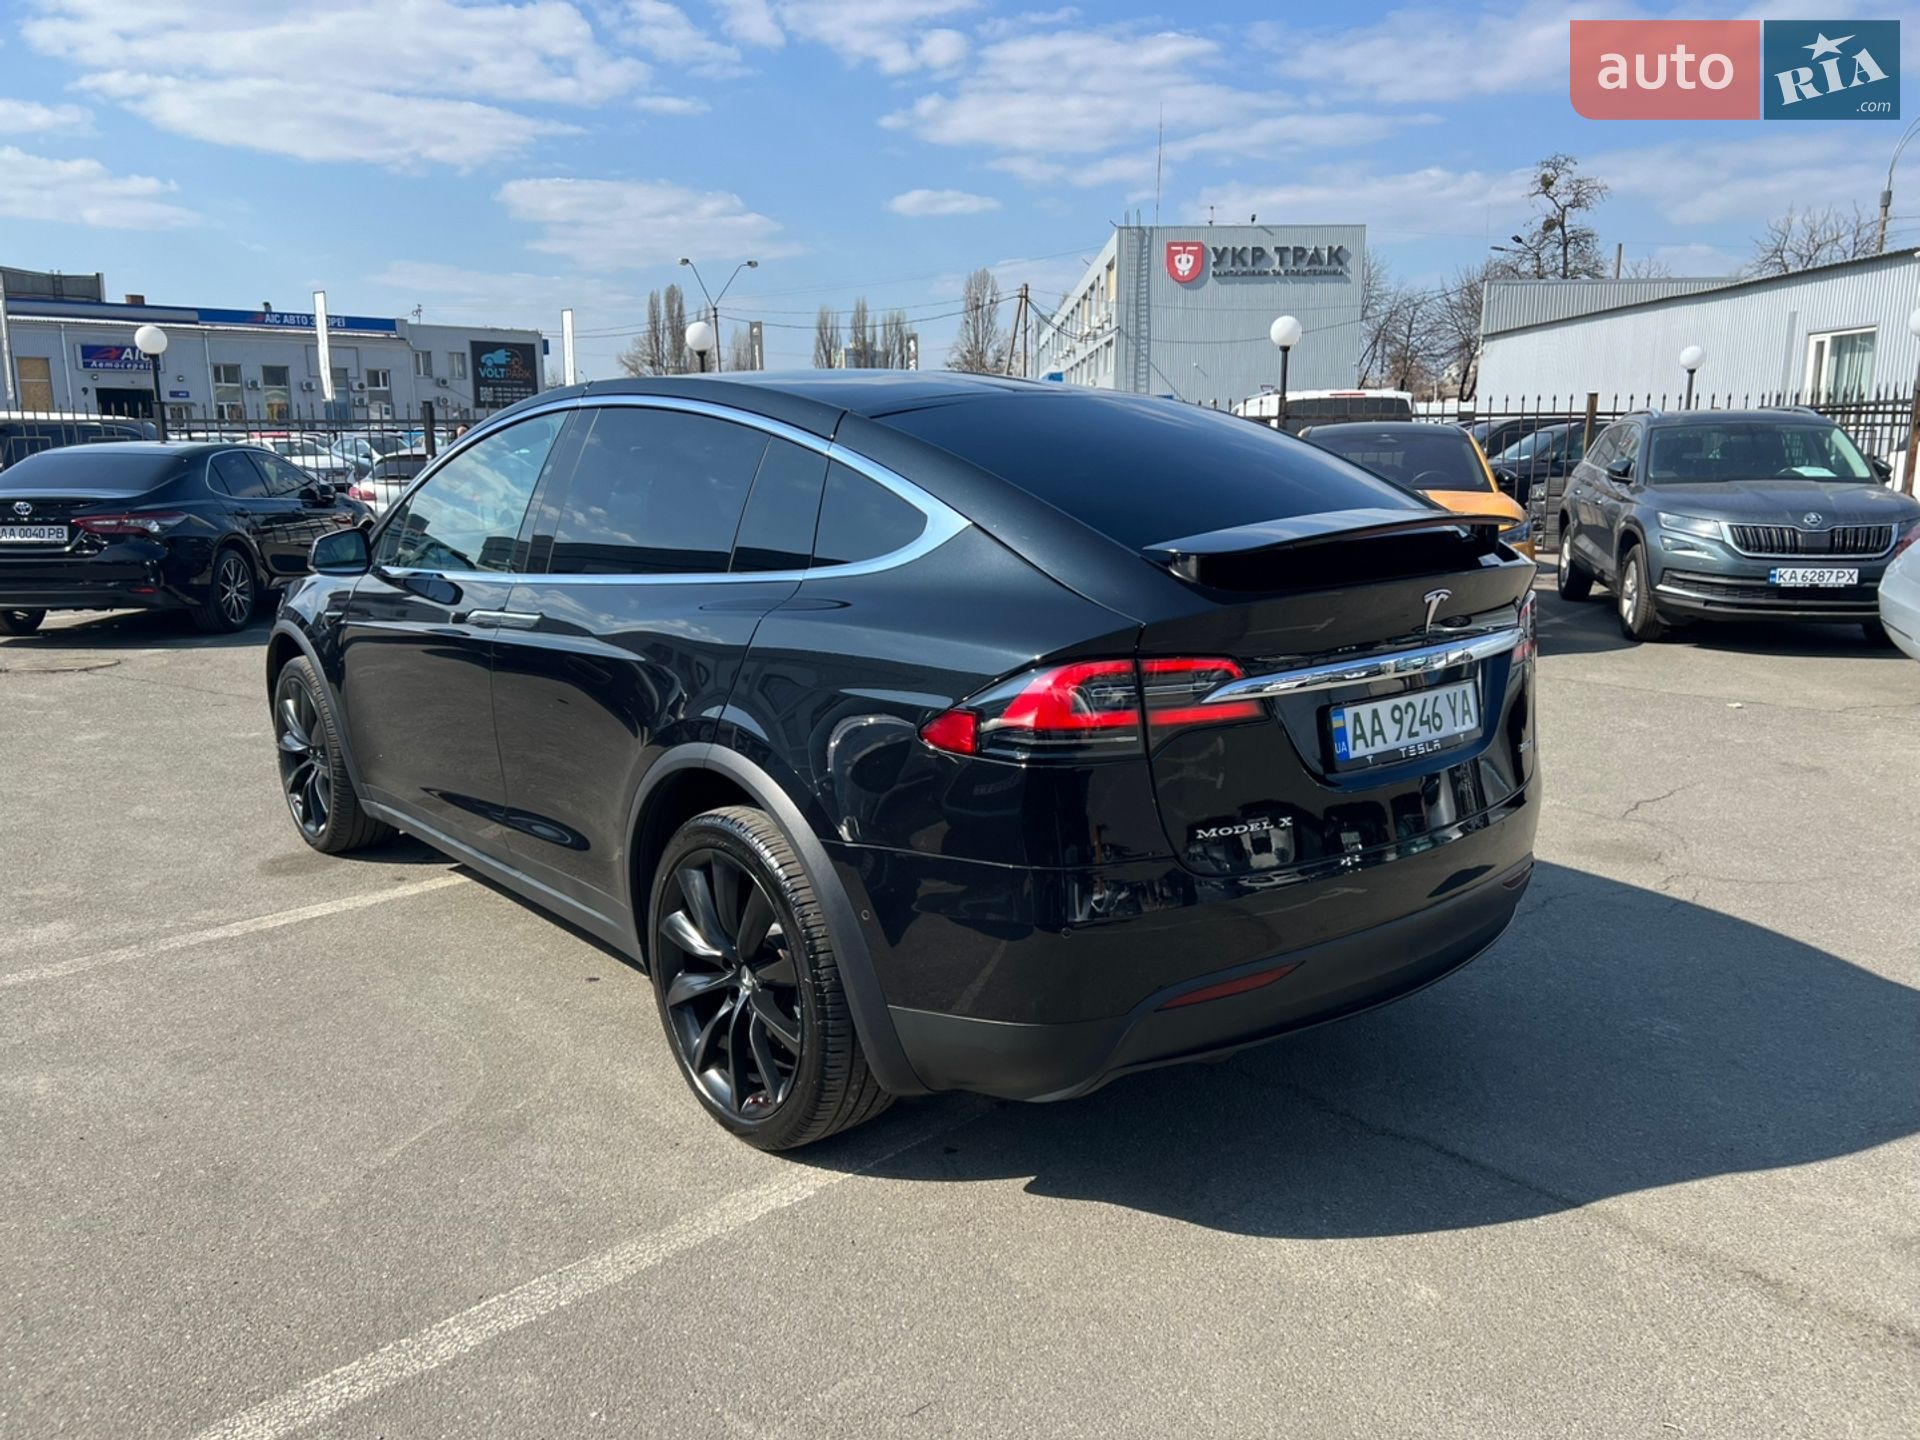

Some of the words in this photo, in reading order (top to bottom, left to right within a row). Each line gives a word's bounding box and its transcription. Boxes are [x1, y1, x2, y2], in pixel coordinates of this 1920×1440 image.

[1212, 246, 1266, 267] УКР
[1274, 245, 1344, 266] ТРАК
[283, 314, 308, 325] АВТО
[1, 528, 16, 539] AA
[18, 528, 45, 538] 0040
[48, 528, 64, 539] PB
[1778, 570, 1797, 582] KA
[1801, 570, 1833, 582] 6287
[1835, 571, 1856, 583] PX
[1352, 708, 1387, 751] AA
[1390, 695, 1443, 742] 9246
[1445, 689, 1473, 727] YA
[1335, 741, 1347, 754] UA
[1399, 740, 1441, 758] TESLA
[1195, 821, 1274, 839] MODEL
[1279, 816, 1292, 827] X
